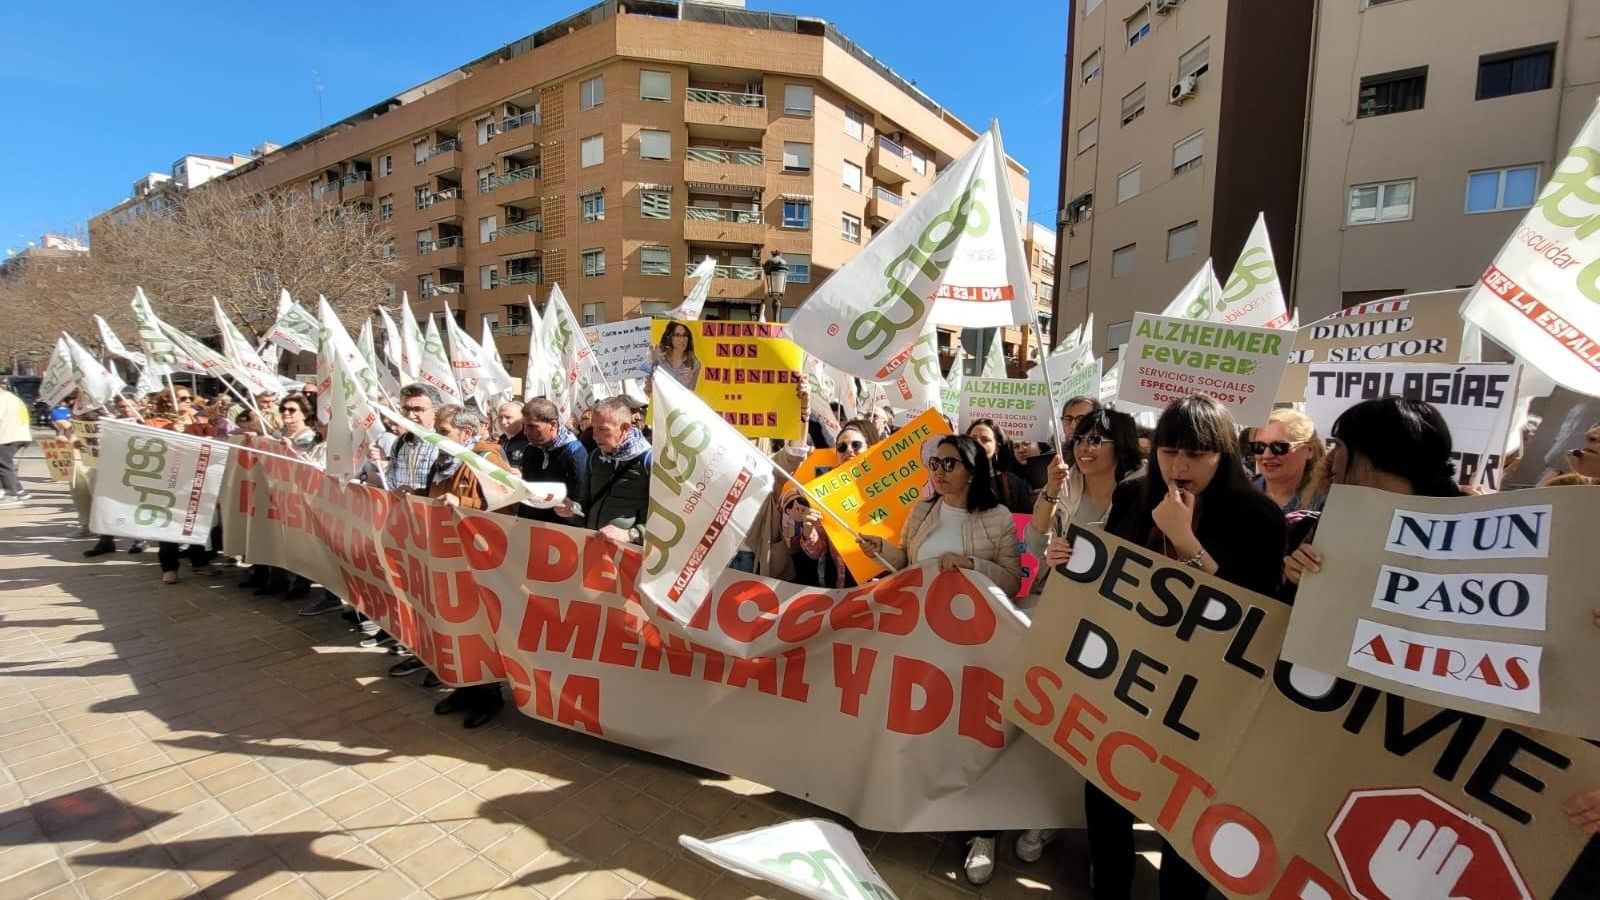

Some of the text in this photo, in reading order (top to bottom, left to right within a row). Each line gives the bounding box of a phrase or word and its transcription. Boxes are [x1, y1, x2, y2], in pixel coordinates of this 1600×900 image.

[1511, 290, 1537, 316] LA
[1136, 319, 1282, 356] ALZHEIMER
[1314, 317, 1412, 340] DIMITE
[717, 344, 758, 358] NOS
[1329, 338, 1444, 363] SECTOR
[705, 367, 800, 384] MIENTES
[964, 380, 1047, 396] ALZHEIMER
[1139, 366, 1255, 393] SERVICIOS SOCIALES
[1141, 379, 1234, 403] ESPECIALIDOS
[1238, 395, 1248, 405] Y
[1309, 366, 1511, 409] TIPOLOGÍAS
[718, 411, 778, 427] ABES
[882, 424, 931, 461] DIMITE
[841, 459, 920, 512] EL SECTOR
[869, 487, 920, 523] YA NO
[1391, 511, 1548, 553] NI UN
[526, 526, 643, 605] DEL
[657, 567, 996, 646] CCESO
[1383, 570, 1531, 618] PASO
[339, 564, 604, 736] DEPENDENCIA
[385, 546, 503, 635] SALUD
[517, 593, 809, 703] MENTAL
[832, 642, 878, 718] Y
[887, 654, 1005, 749] DE
[1354, 634, 1531, 692] ATRAS
[1065, 618, 1200, 742] DEL
